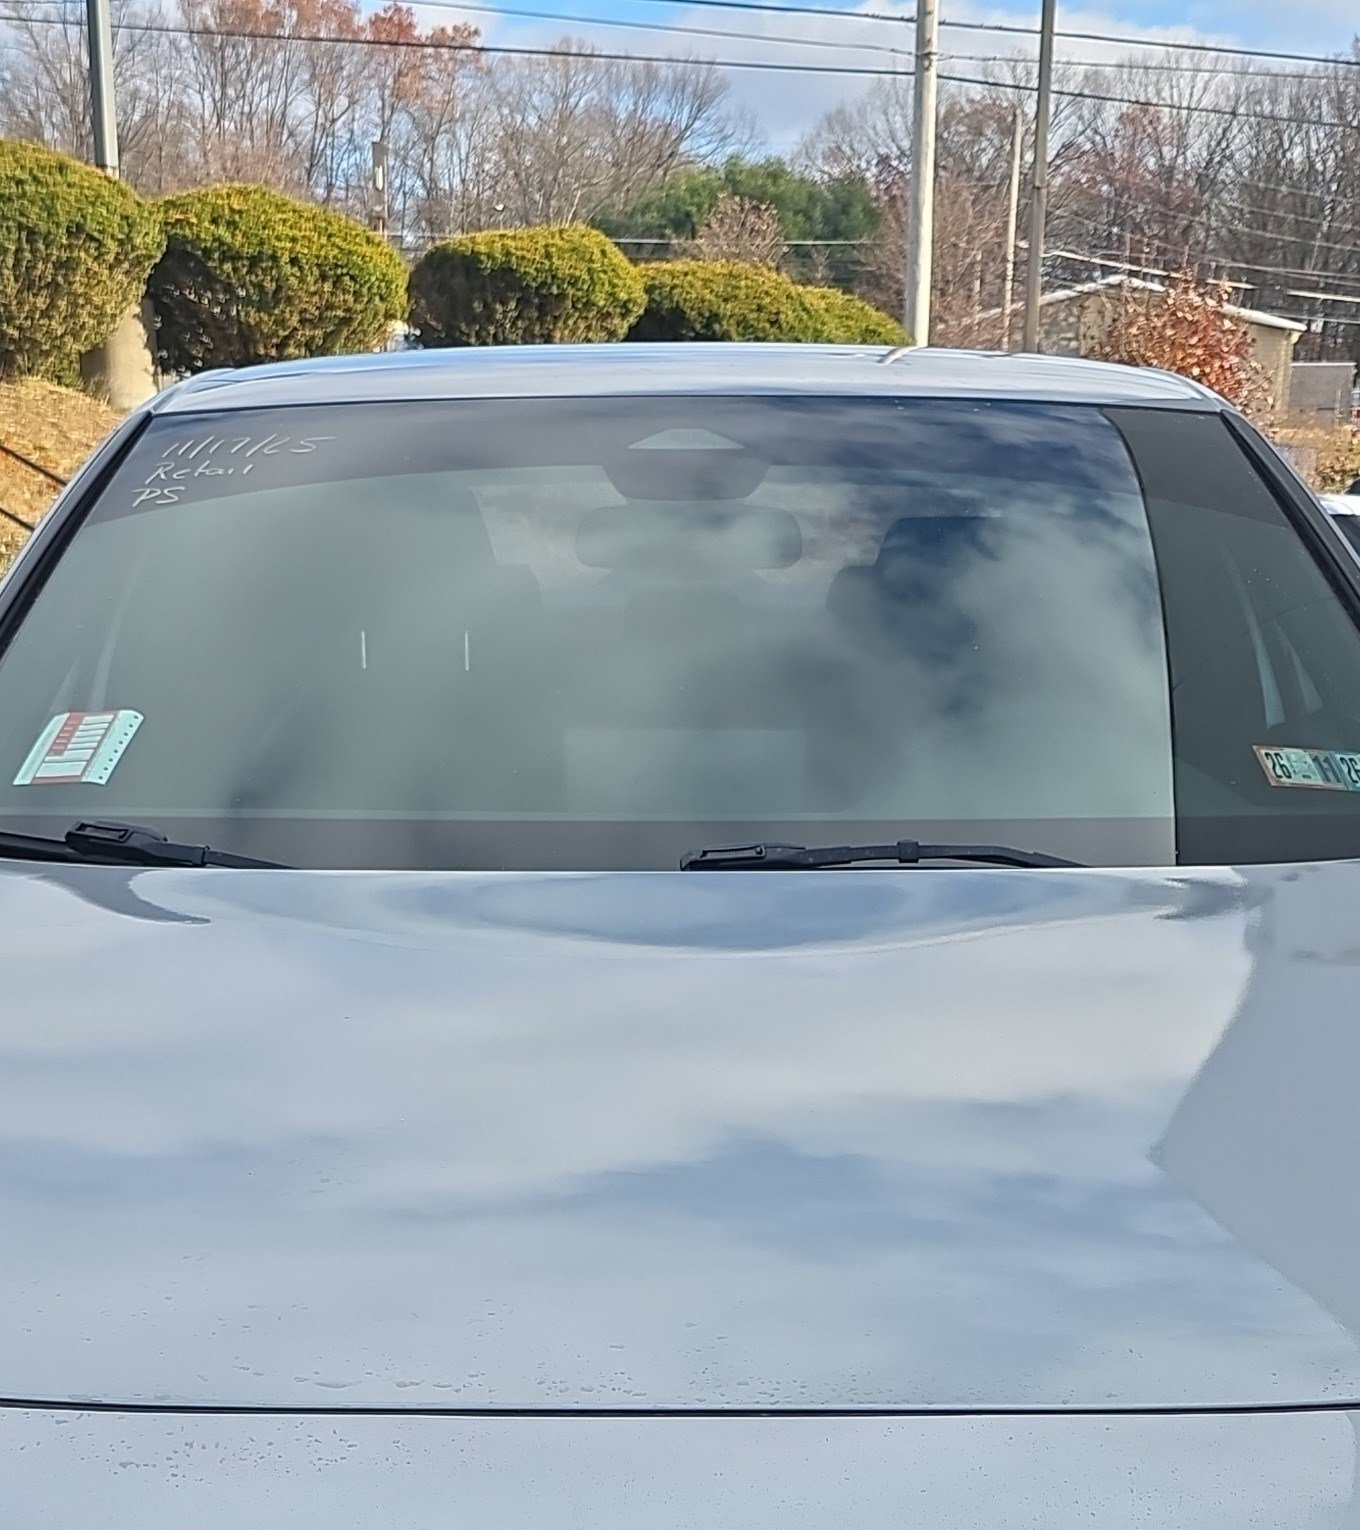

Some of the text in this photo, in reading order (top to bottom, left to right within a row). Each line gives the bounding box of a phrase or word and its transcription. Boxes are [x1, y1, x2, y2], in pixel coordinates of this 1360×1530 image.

[144, 460, 253, 485] Retail
[131, 486, 185, 507] PS
[1264, 752, 1292, 779] 26
